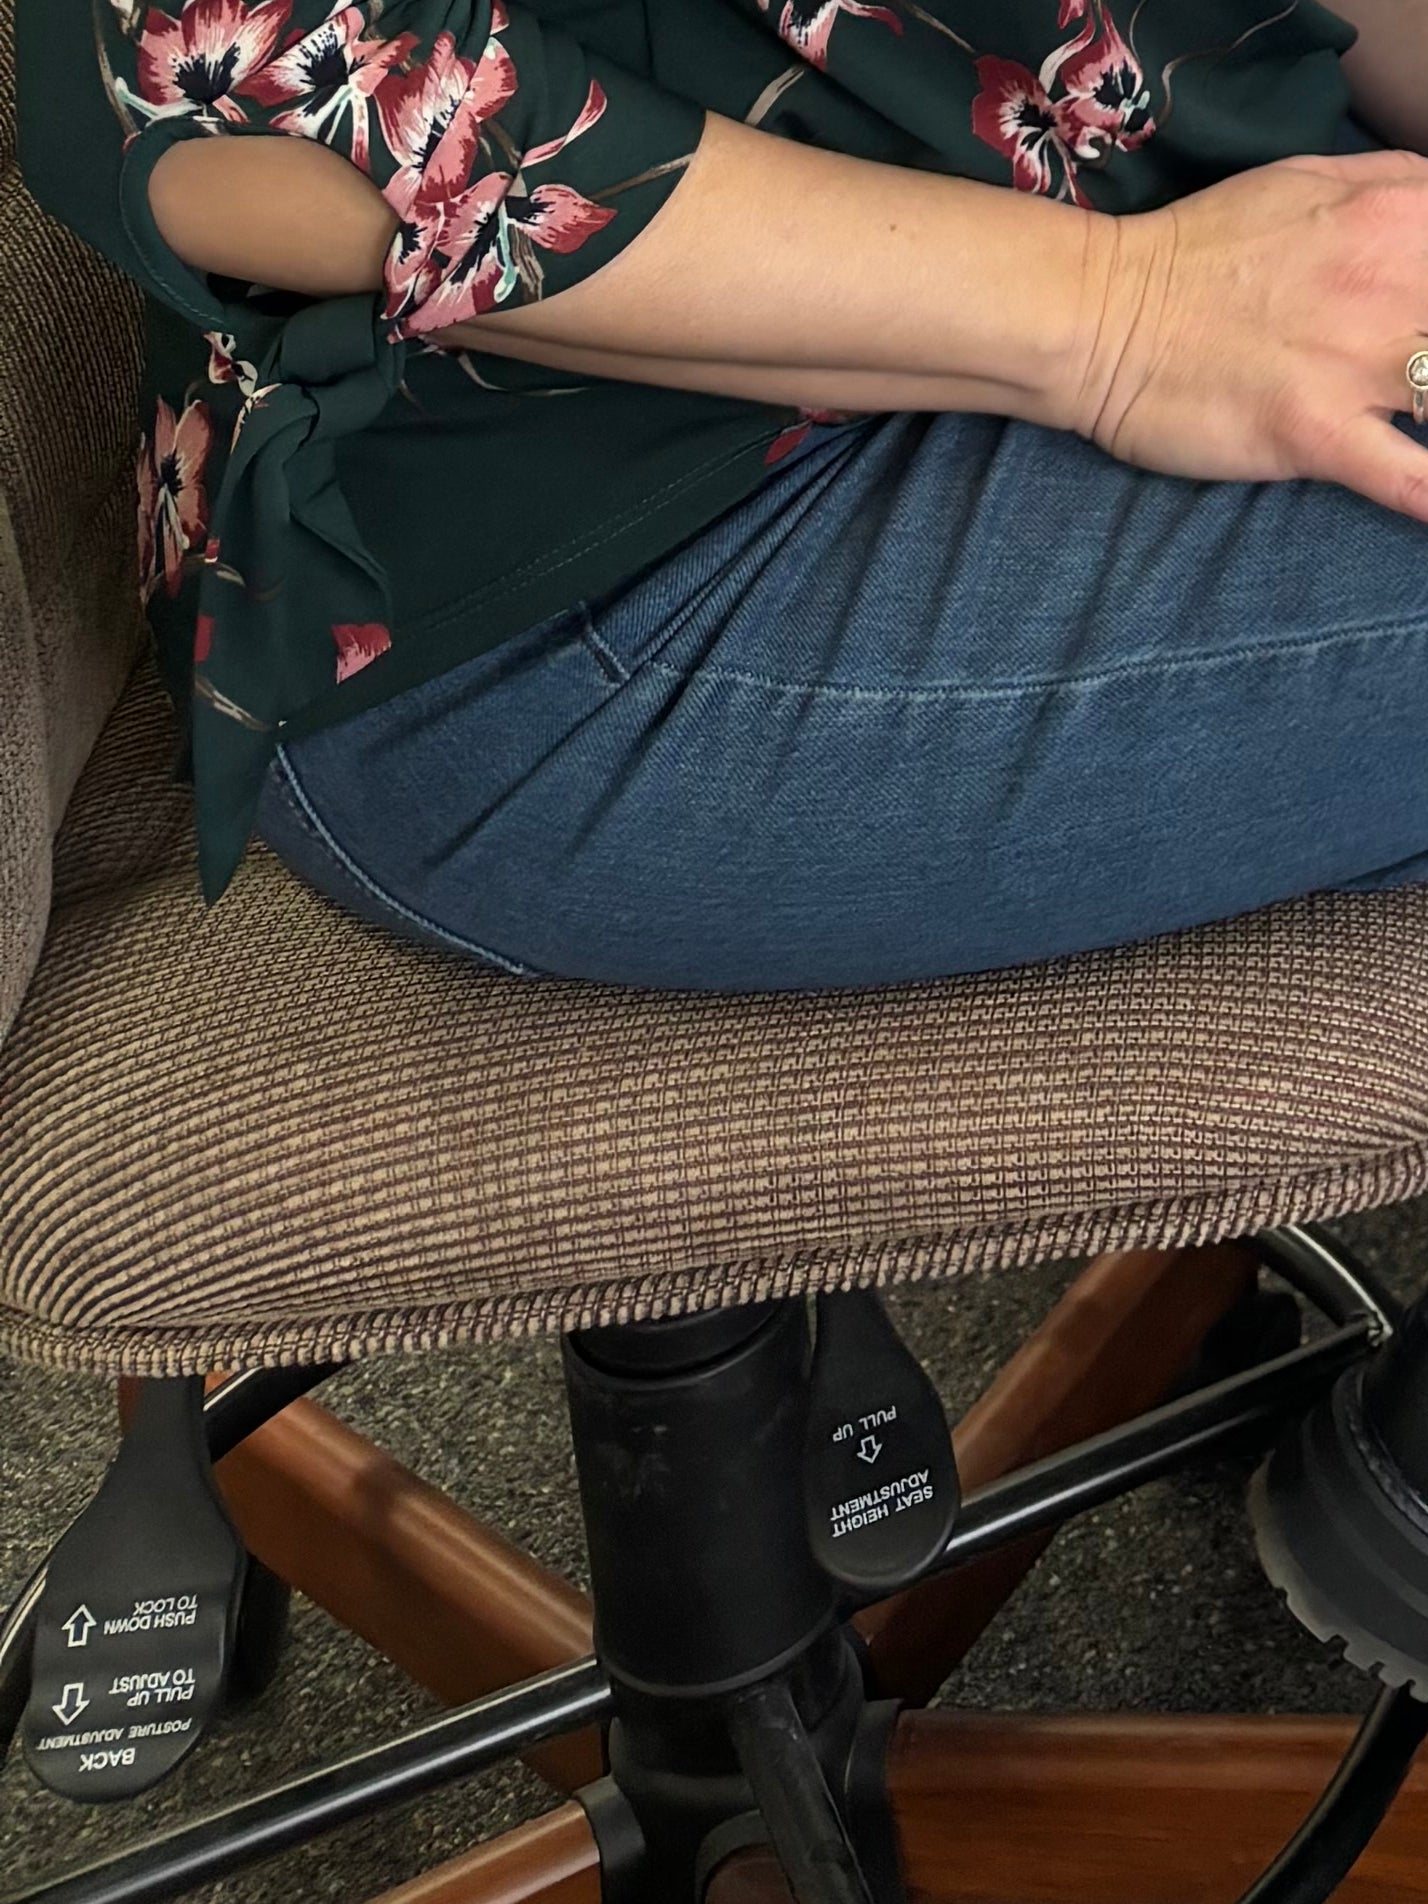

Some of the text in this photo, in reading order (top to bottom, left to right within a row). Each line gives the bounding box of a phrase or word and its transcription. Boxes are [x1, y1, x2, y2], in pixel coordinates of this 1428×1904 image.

[832, 1405, 897, 1442] PULL UP
[830, 1468, 929, 1522] ADJUSTMENT
[832, 1485, 934, 1538] SEAT HEIGHT
[133, 1594, 199, 1616] TO LOCK
[103, 1609, 197, 1635] PUSH DOWN
[108, 1668, 196, 1695] TO ADJUST
[126, 1684, 195, 1707] PULL UP
[35, 1717, 193, 1751] POSTURE ADJUSTMENT
[78, 1747, 136, 1773] BACK
